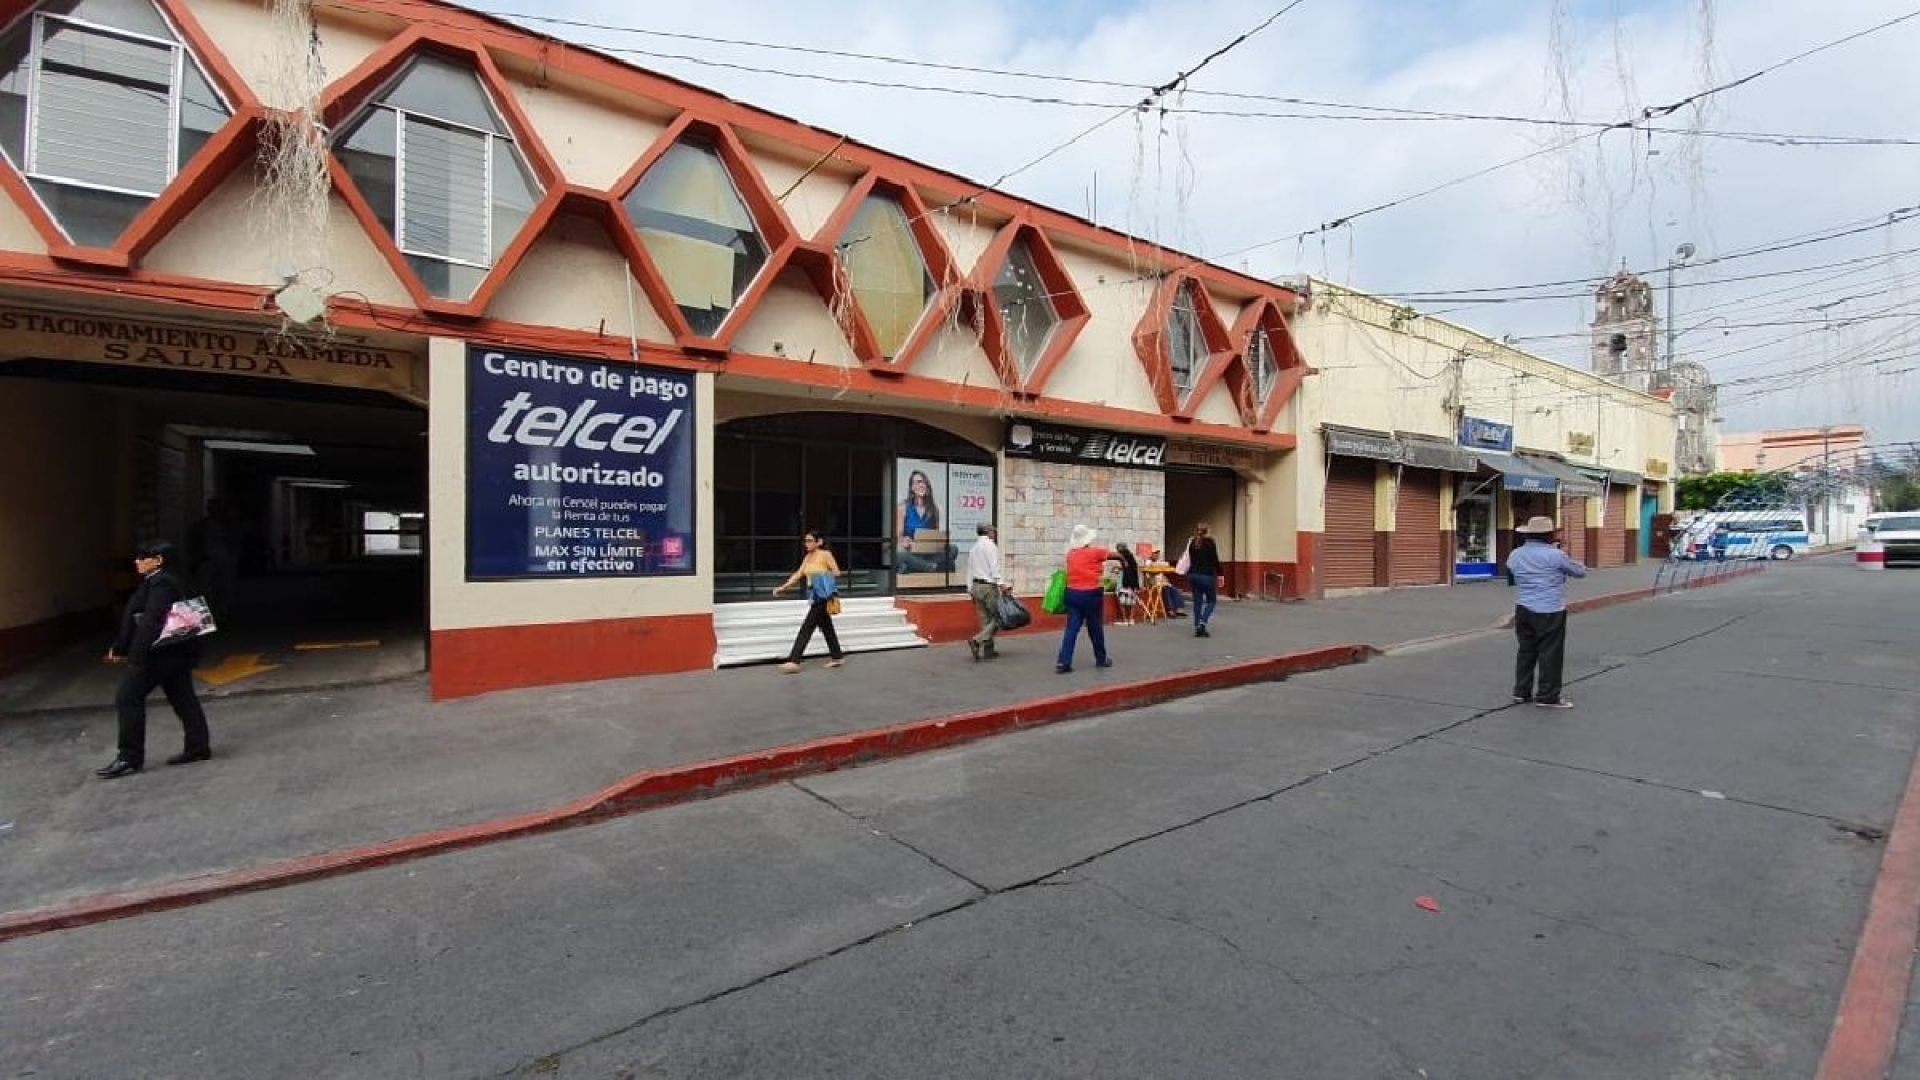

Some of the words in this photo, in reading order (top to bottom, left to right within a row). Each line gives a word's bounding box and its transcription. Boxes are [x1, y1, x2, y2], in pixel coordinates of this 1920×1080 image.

[0, 311, 237, 351] STACIONAMIENTO
[104, 343, 291, 375] SALIDA
[483, 352, 584, 385] Centro
[591, 366, 624, 390] de
[629, 375, 689, 401] pago
[487, 391, 684, 455] telcel
[1104, 437, 1166, 465] telcel
[513, 462, 664, 487] autorizado
[508, 494, 545, 508] Ahora
[546, 498, 561, 508] en
[600, 499, 637, 511] puedes
[639, 501, 668, 514] pagar
[552, 510, 561, 520] la
[564, 510, 596, 521] Renta
[598, 511, 611, 521] de
[613, 512, 630, 523] tus
[535, 526, 590, 539] PLANES
[595, 528, 641, 540] TELCEL
[535, 545, 570, 557] MAX
[573, 545, 596, 557] SIN
[599, 543, 645, 558] LÍMITE
[546, 560, 567, 571] en
[570, 557, 635, 574] efectivo
